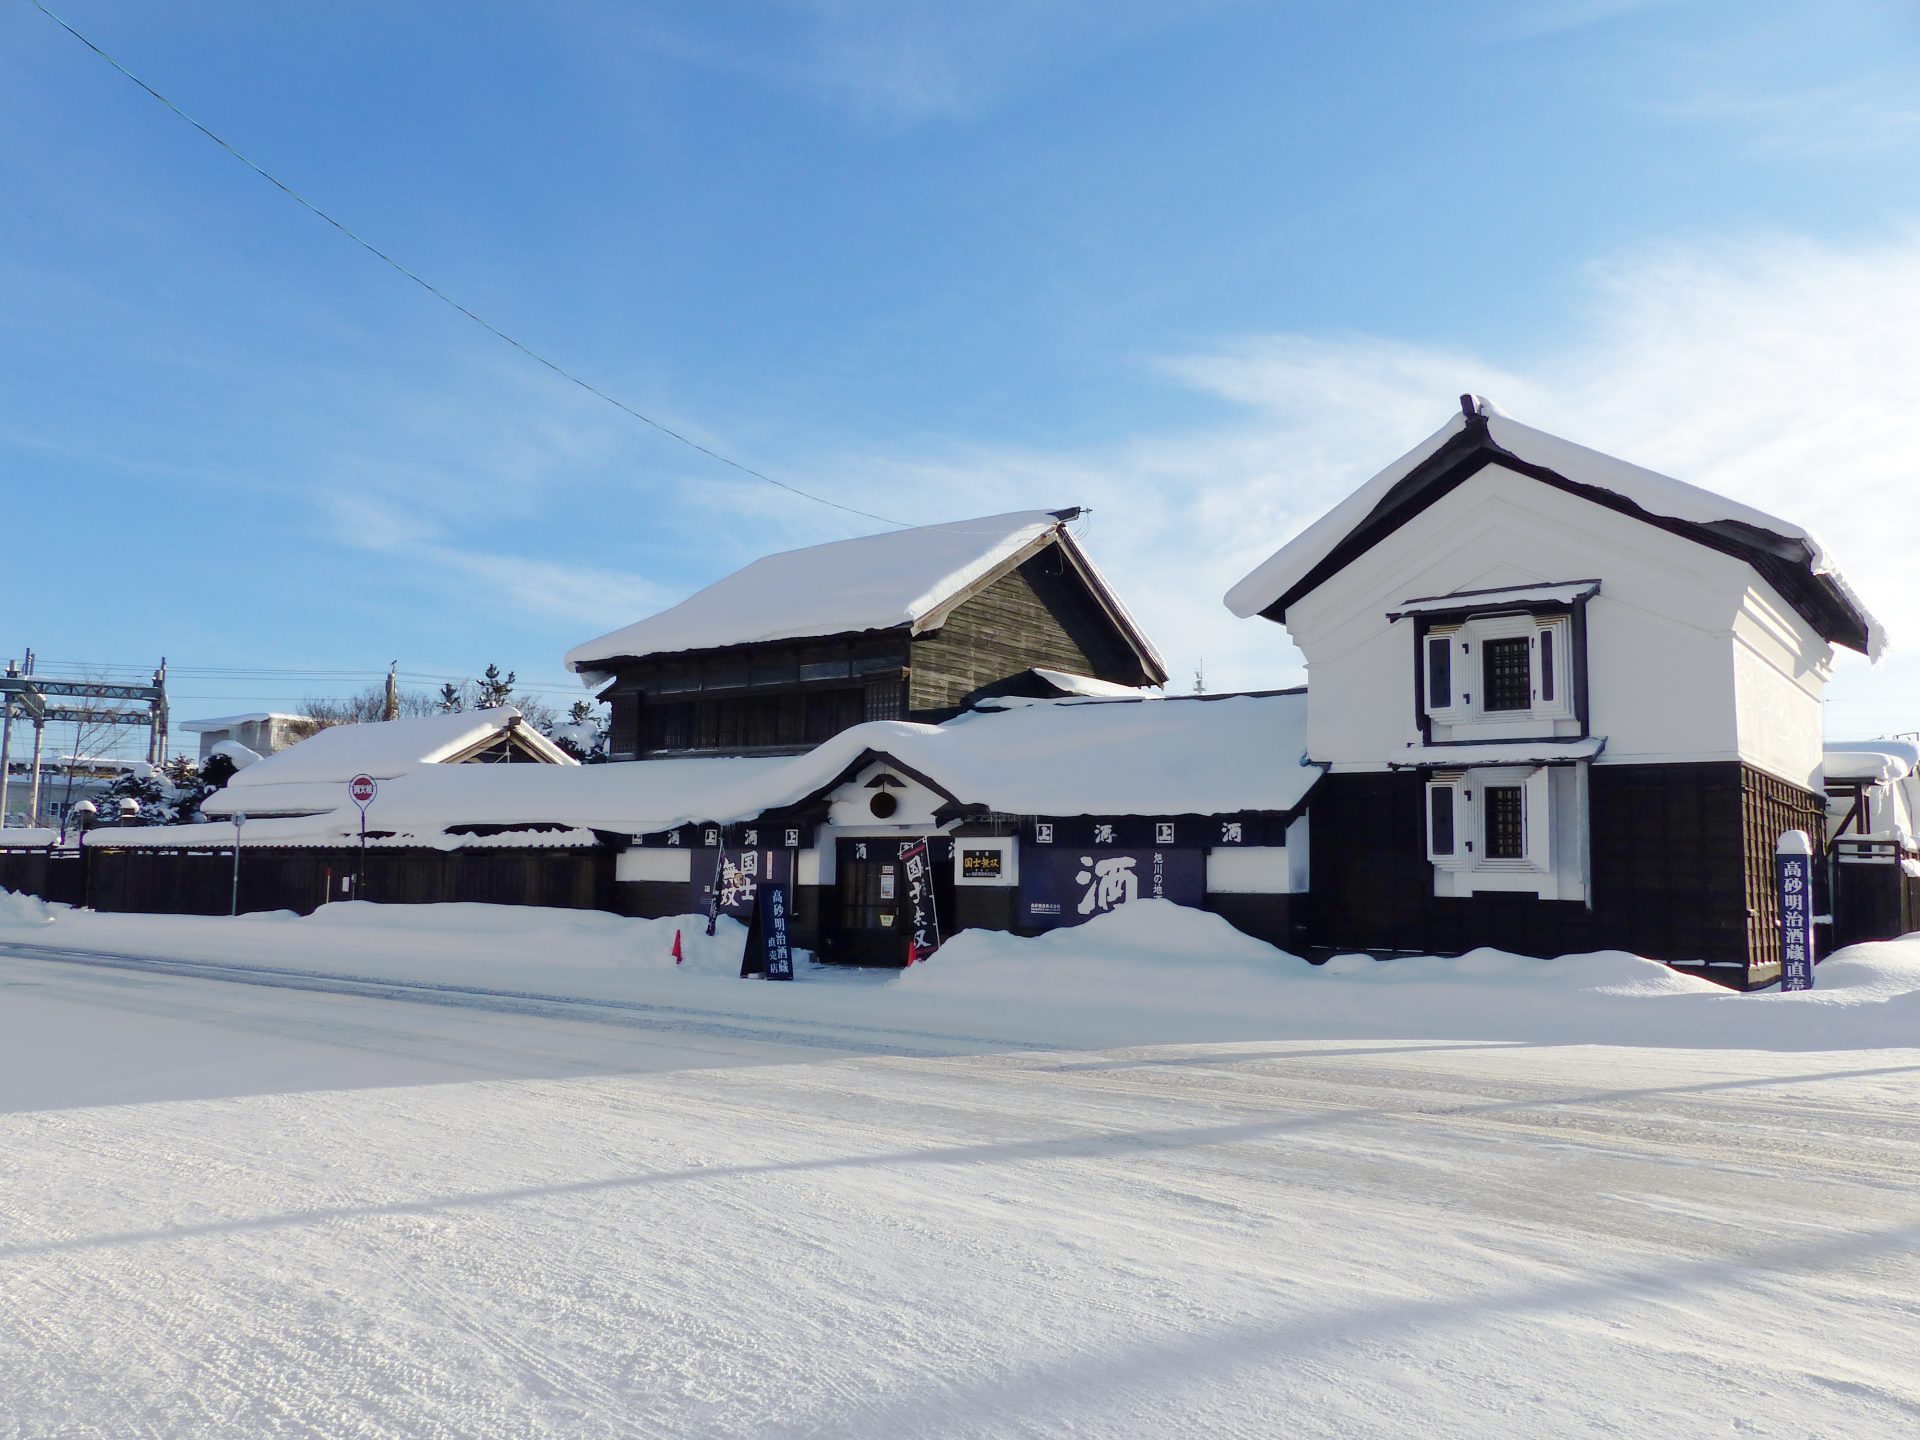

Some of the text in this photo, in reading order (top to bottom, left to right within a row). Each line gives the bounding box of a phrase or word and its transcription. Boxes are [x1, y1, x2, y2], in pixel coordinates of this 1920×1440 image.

[744, 829, 757, 845] 酒
[1095, 825, 1112, 843] 酒
[1221, 822, 1242, 842] 酒
[856, 843, 867, 860] 酒
[964, 856, 999, 869] 国士無双
[1075, 856, 1137, 914] 酒
[772, 889, 789, 973] 高砂明治酒蔵
